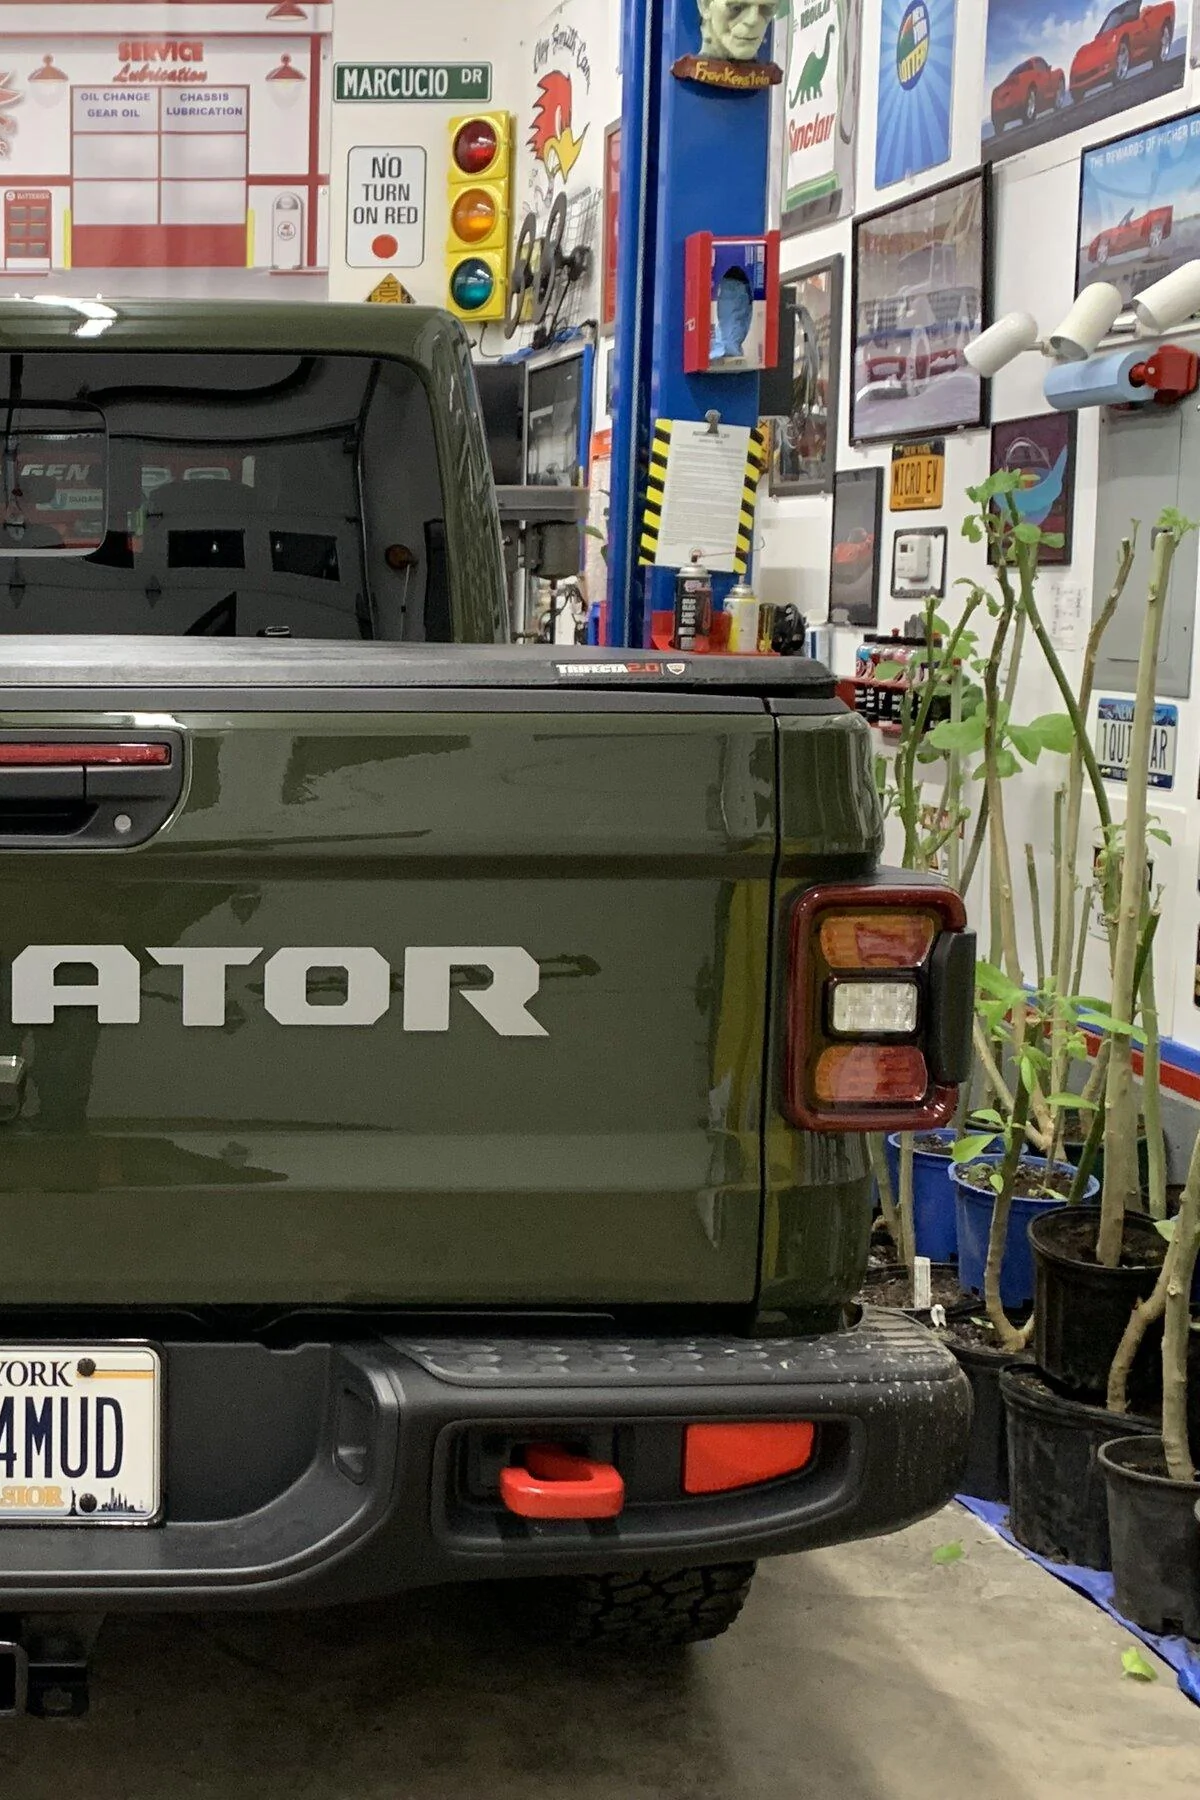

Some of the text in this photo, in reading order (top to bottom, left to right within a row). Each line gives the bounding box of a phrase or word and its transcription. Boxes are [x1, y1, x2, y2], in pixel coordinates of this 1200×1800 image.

[117, 40, 204, 62] SERVICE
[112, 62, 208, 83] Lubrication
[343, 68, 482, 97] MARCUCIO DR
[694, 61, 771, 87] Frankenstein
[80, 92, 151, 101] OIL CHANGE
[180, 93, 230, 102] CHASSIS
[87, 108, 140, 118] GEAR OIL
[166, 106, 243, 116] LUBRICATION
[788, 112, 836, 154] Sinclair
[371, 156, 402, 179] NO
[362, 183, 410, 201] TURN
[353, 206, 418, 225] ON RED
[893, 461, 921, 496] MICRO
[555, 662, 659, 674] TRIFECTA 2.0
